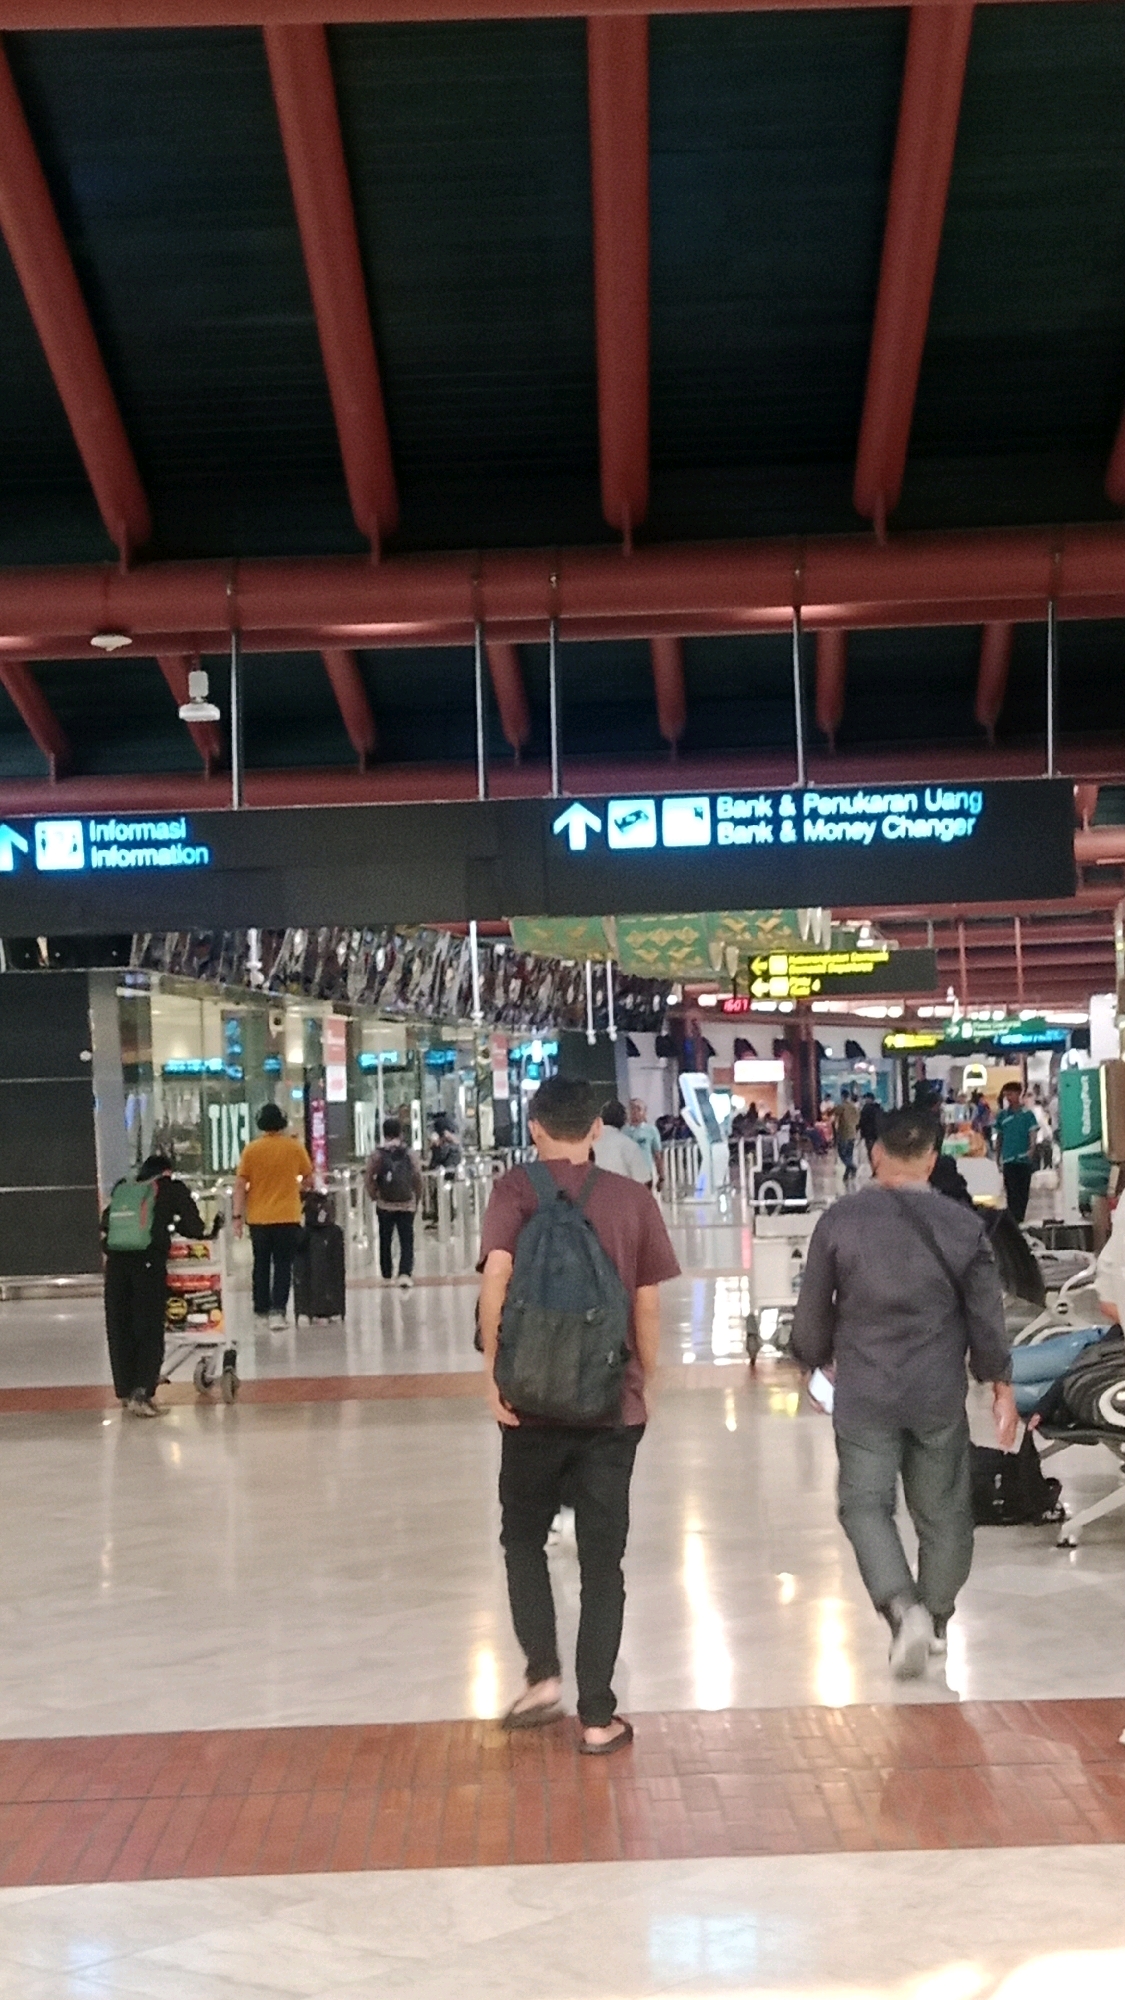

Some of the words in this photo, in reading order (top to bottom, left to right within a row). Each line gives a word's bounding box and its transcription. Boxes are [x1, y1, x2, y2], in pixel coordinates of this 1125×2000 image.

[717, 795, 773, 819] Bank
[778, 794, 797, 818] &
[803, 790, 918, 816] Penukaran
[924, 787, 983, 814] Uang
[89, 817, 187, 842] Informasi
[717, 821, 774, 845] Bank
[779, 820, 797, 843] &
[803, 818, 877, 845] Money
[882, 815, 977, 842] Changer
[91, 843, 209, 868] Information
